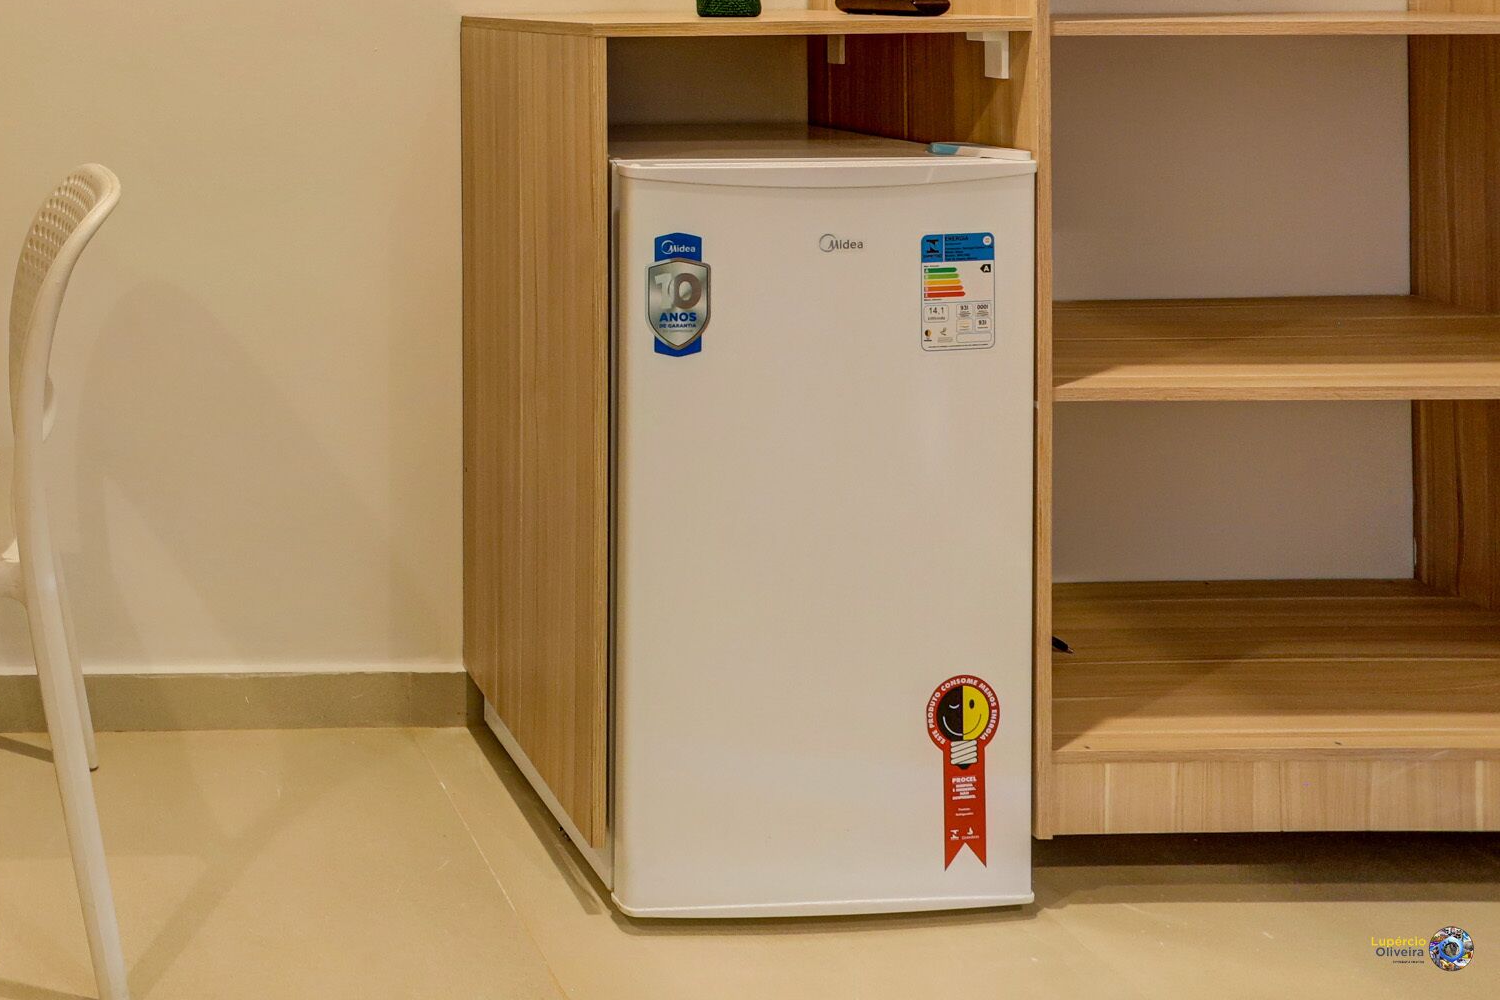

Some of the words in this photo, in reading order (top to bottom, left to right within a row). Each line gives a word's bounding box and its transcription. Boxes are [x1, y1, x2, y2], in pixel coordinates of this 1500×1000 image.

[661, 240, 696, 255] Midea
[819, 234, 864, 252] Midea
[654, 272, 702, 309] 10
[659, 312, 697, 322] ANOS
[940, 677, 978, 692] CONSOME
[978, 682, 997, 707] MENOS
[927, 691, 941, 729] PRODUTO
[979, 708, 998, 741] ENERGIA
[931, 729, 946, 745] ESTE
[952, 776, 977, 784] PROCEL
